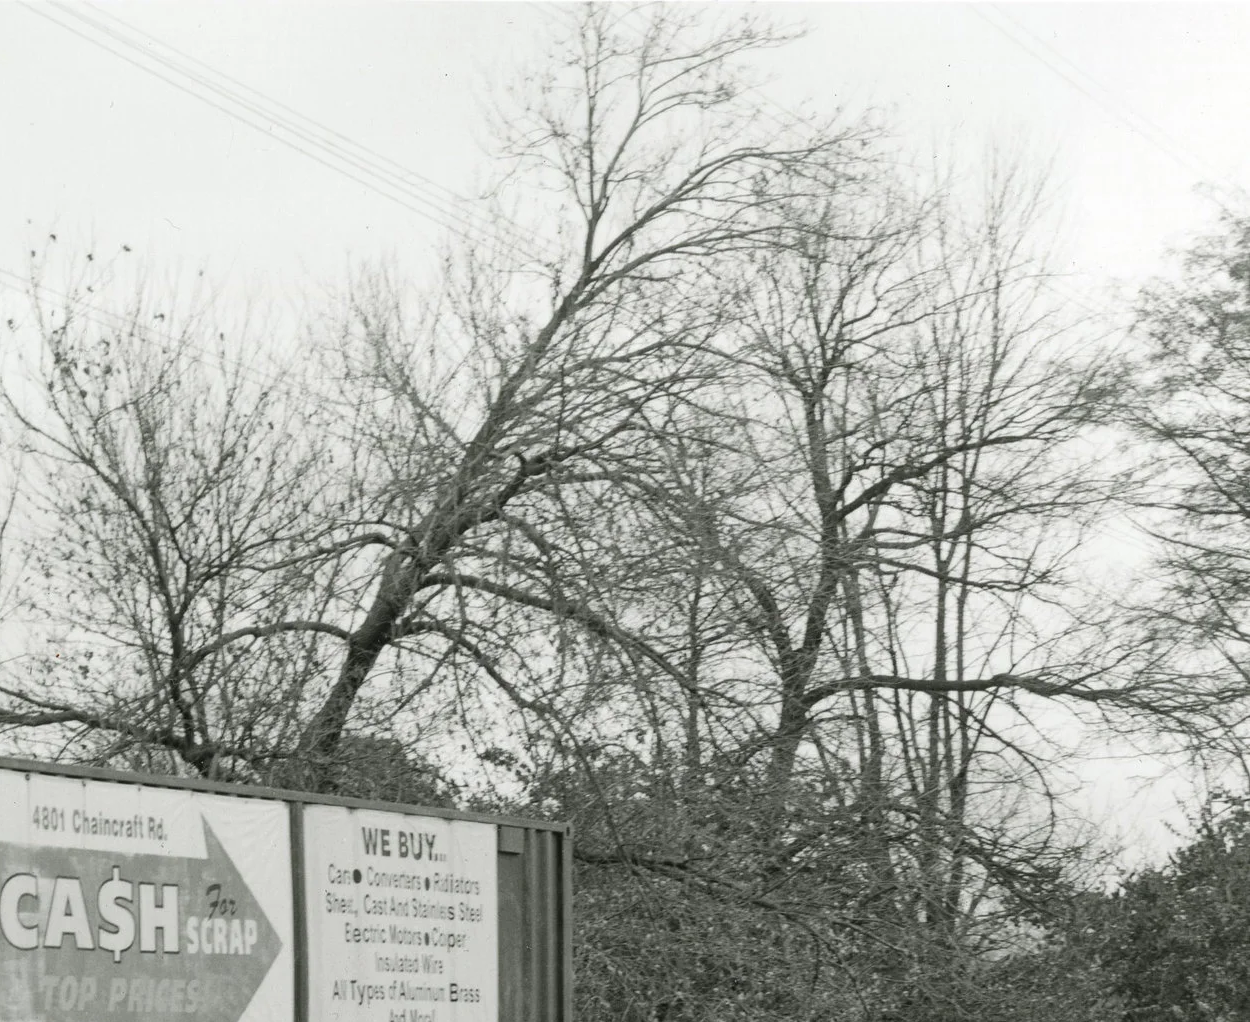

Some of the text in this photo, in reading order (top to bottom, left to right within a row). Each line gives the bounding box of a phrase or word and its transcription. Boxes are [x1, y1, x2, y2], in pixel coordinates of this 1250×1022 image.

[33, 805, 168, 841] 4801 Chaincraft Rd.
[362, 827, 391, 857] WE
[206, 883, 238, 920] For
[458, 902, 483, 922] Steel
[187, 916, 257, 955] SCRAP
[345, 922, 387, 944] Eectric
[421, 954, 443, 975] Wire
[40, 976, 97, 1011] TOP
[350, 979, 385, 1007] Types
[450, 983, 480, 1003] Brass
